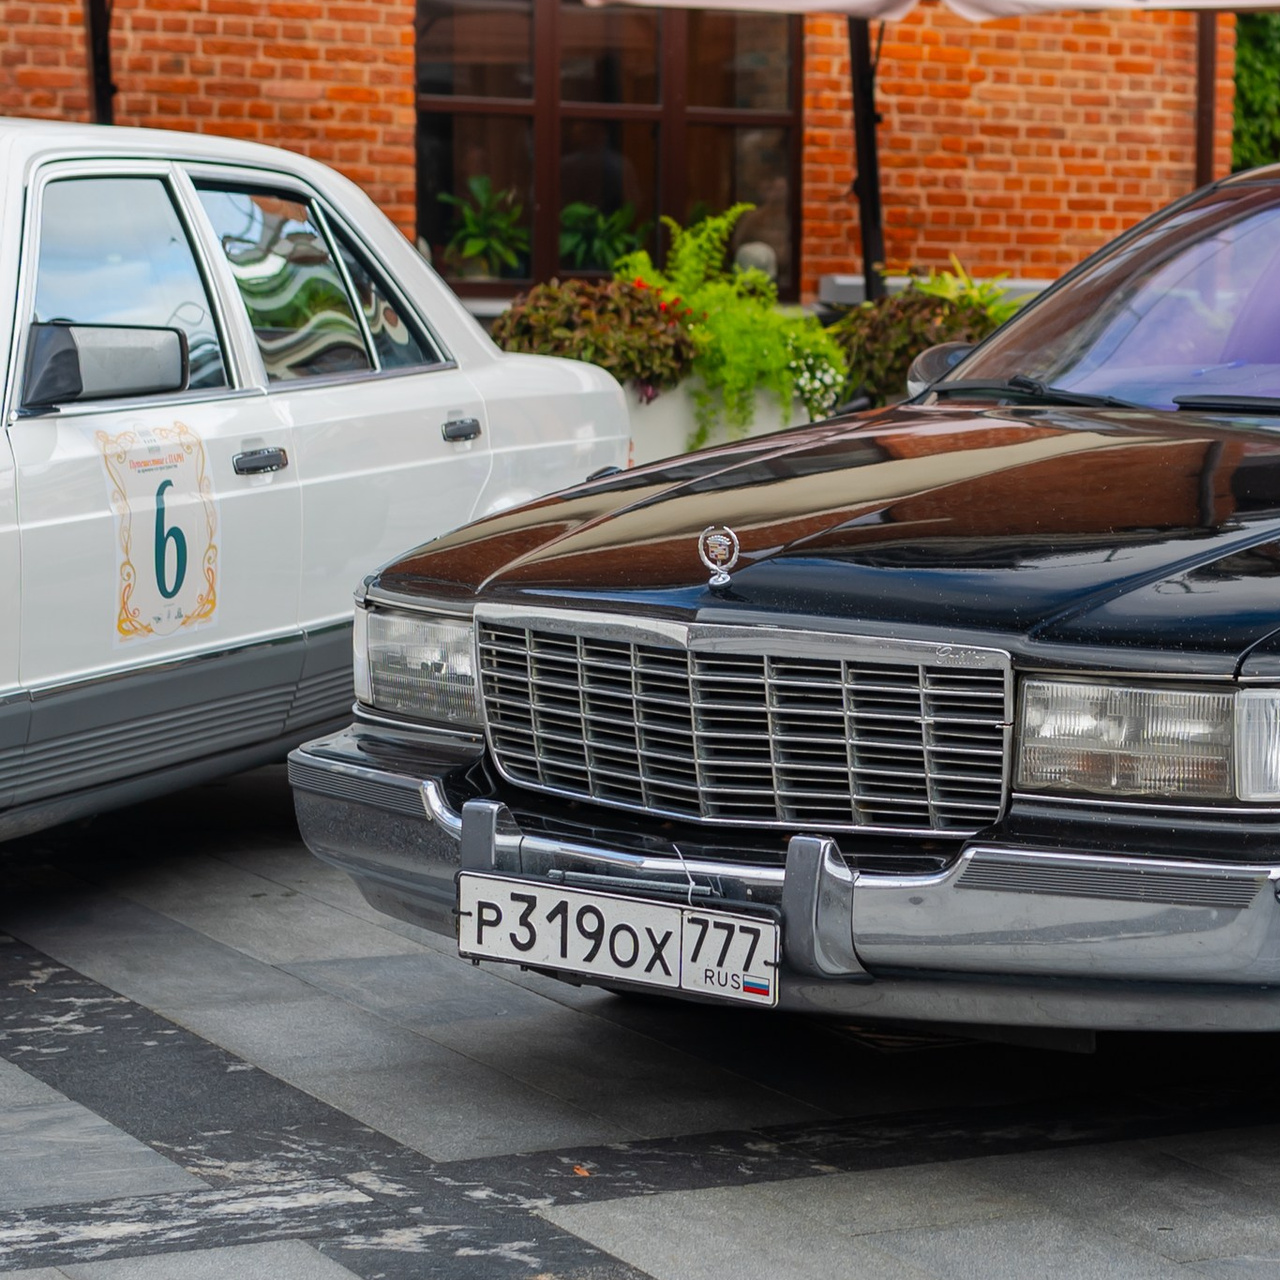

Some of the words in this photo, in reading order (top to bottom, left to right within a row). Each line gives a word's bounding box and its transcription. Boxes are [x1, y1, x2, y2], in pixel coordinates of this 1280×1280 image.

[155, 479, 187, 599] 6
[687, 916, 762, 972] 777
[704, 968, 741, 990] RUS
